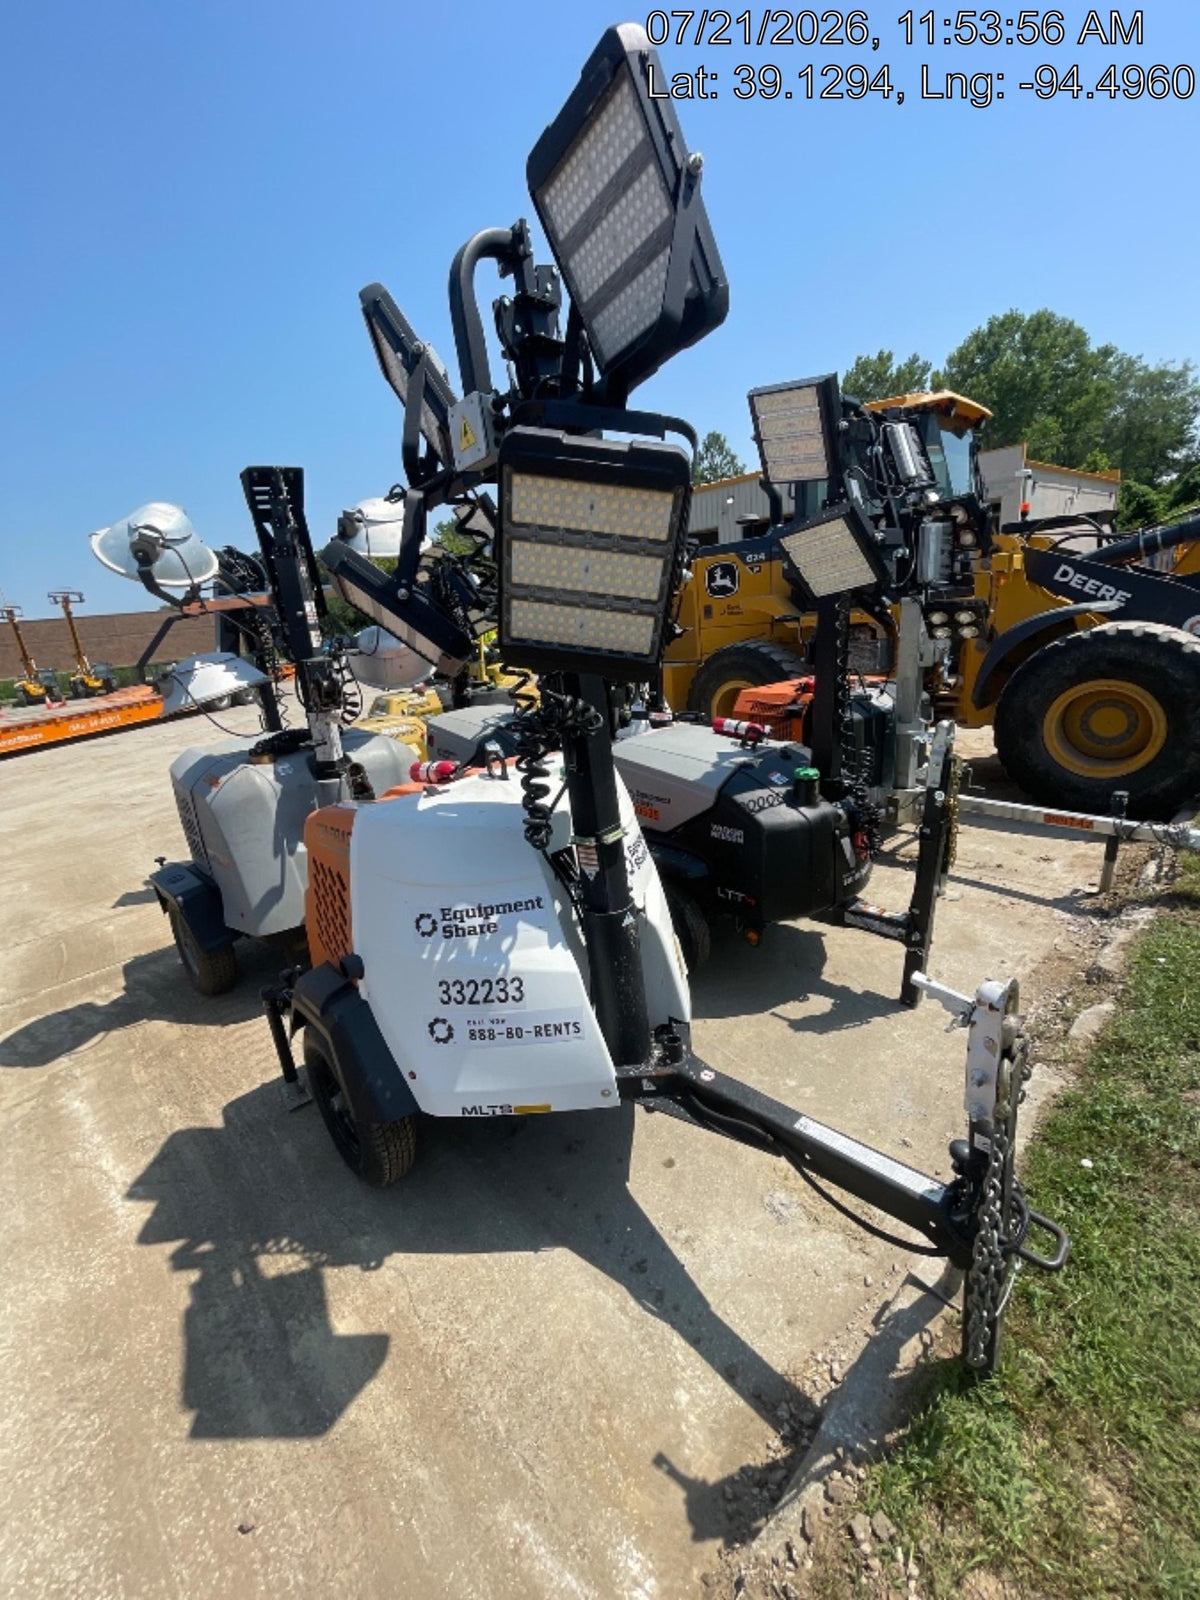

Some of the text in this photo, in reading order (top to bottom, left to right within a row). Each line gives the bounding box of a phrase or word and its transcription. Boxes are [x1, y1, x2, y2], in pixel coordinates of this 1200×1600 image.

[1053, 563, 1133, 606] DEERE
[440, 896, 544, 923] Equipment
[442, 922, 498, 939] Share
[438, 976, 525, 1005] 332233
[468, 1021, 582, 1041] 888-80-RENTS
